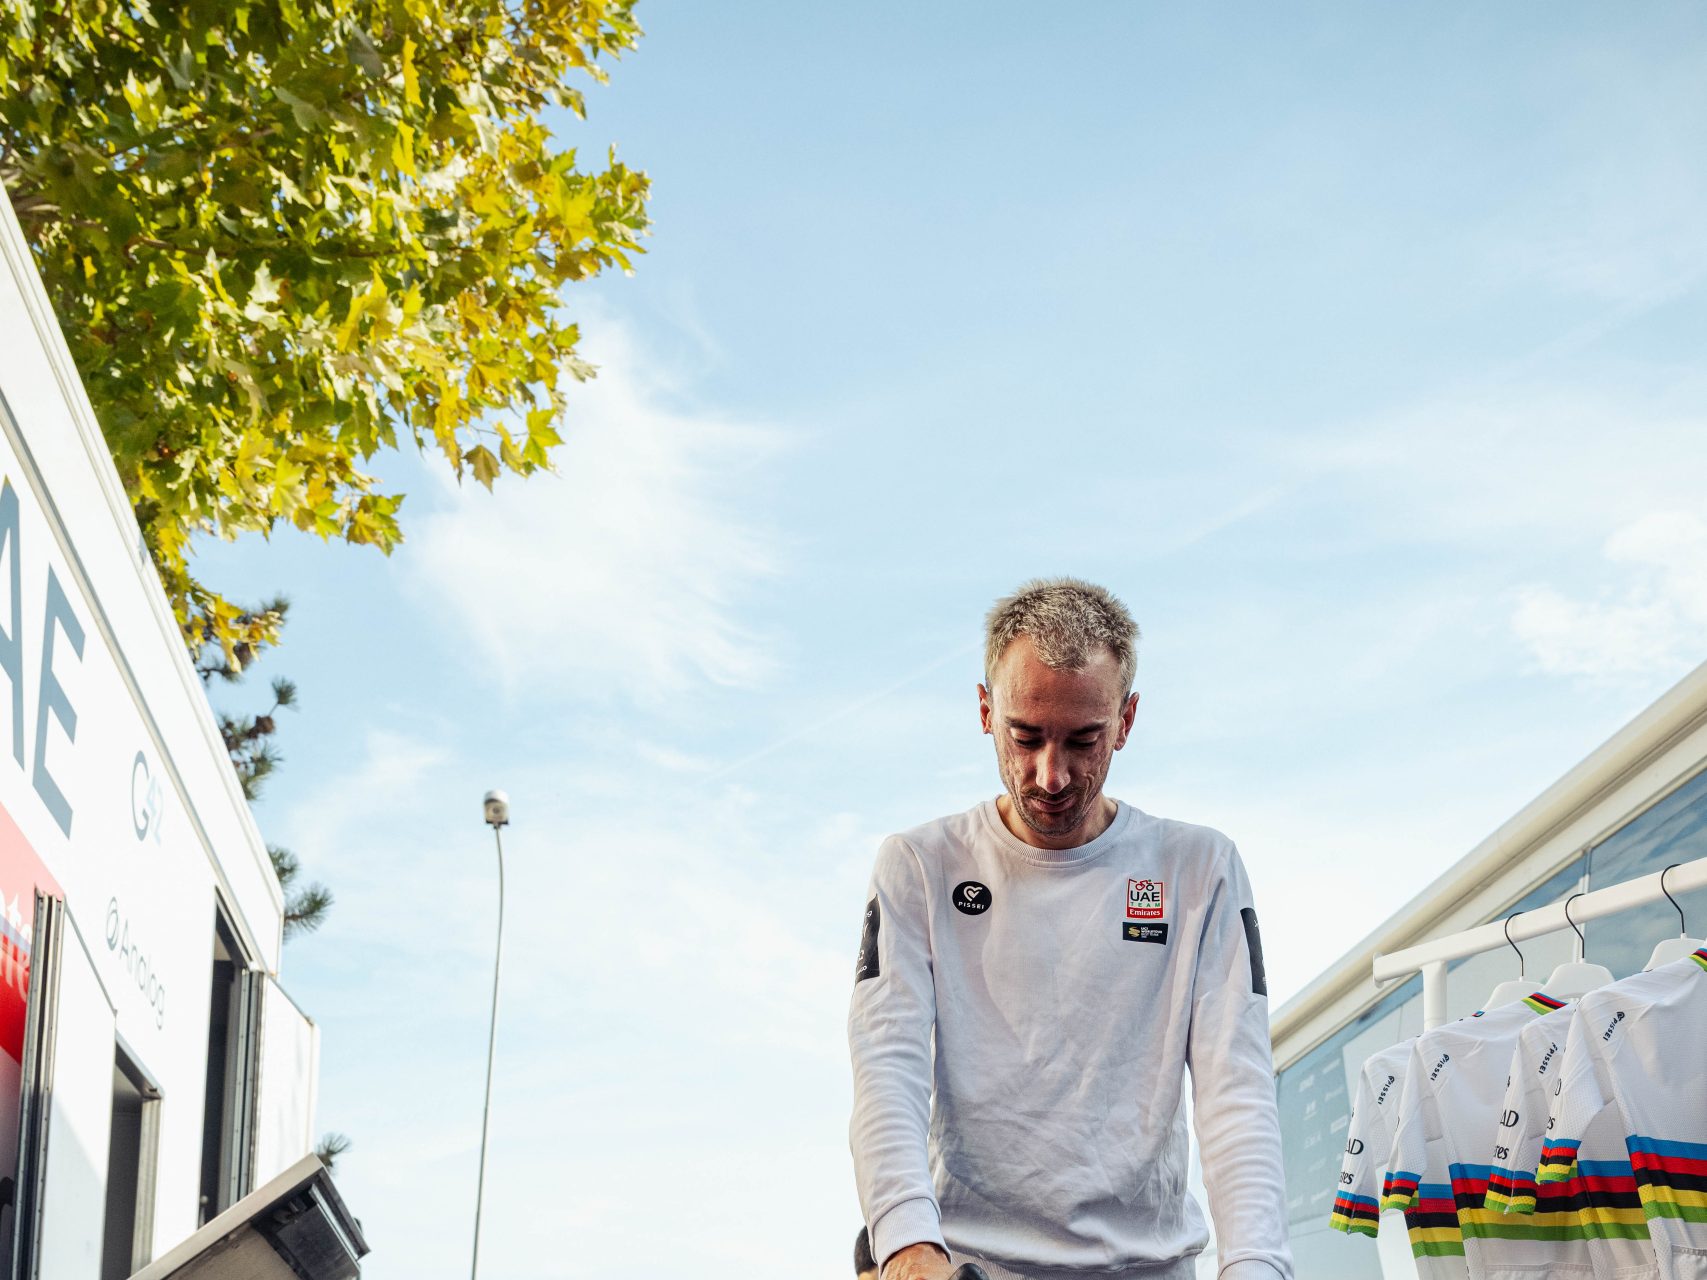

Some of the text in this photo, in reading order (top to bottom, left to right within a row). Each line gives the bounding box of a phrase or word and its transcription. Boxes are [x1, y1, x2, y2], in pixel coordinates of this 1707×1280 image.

[1130, 890, 1160, 902] UAE
[958, 901, 985, 910] PISSEI
[1603, 1018, 1619, 1041] PISSEI
[1538, 1047, 1555, 1074] PISSEI
